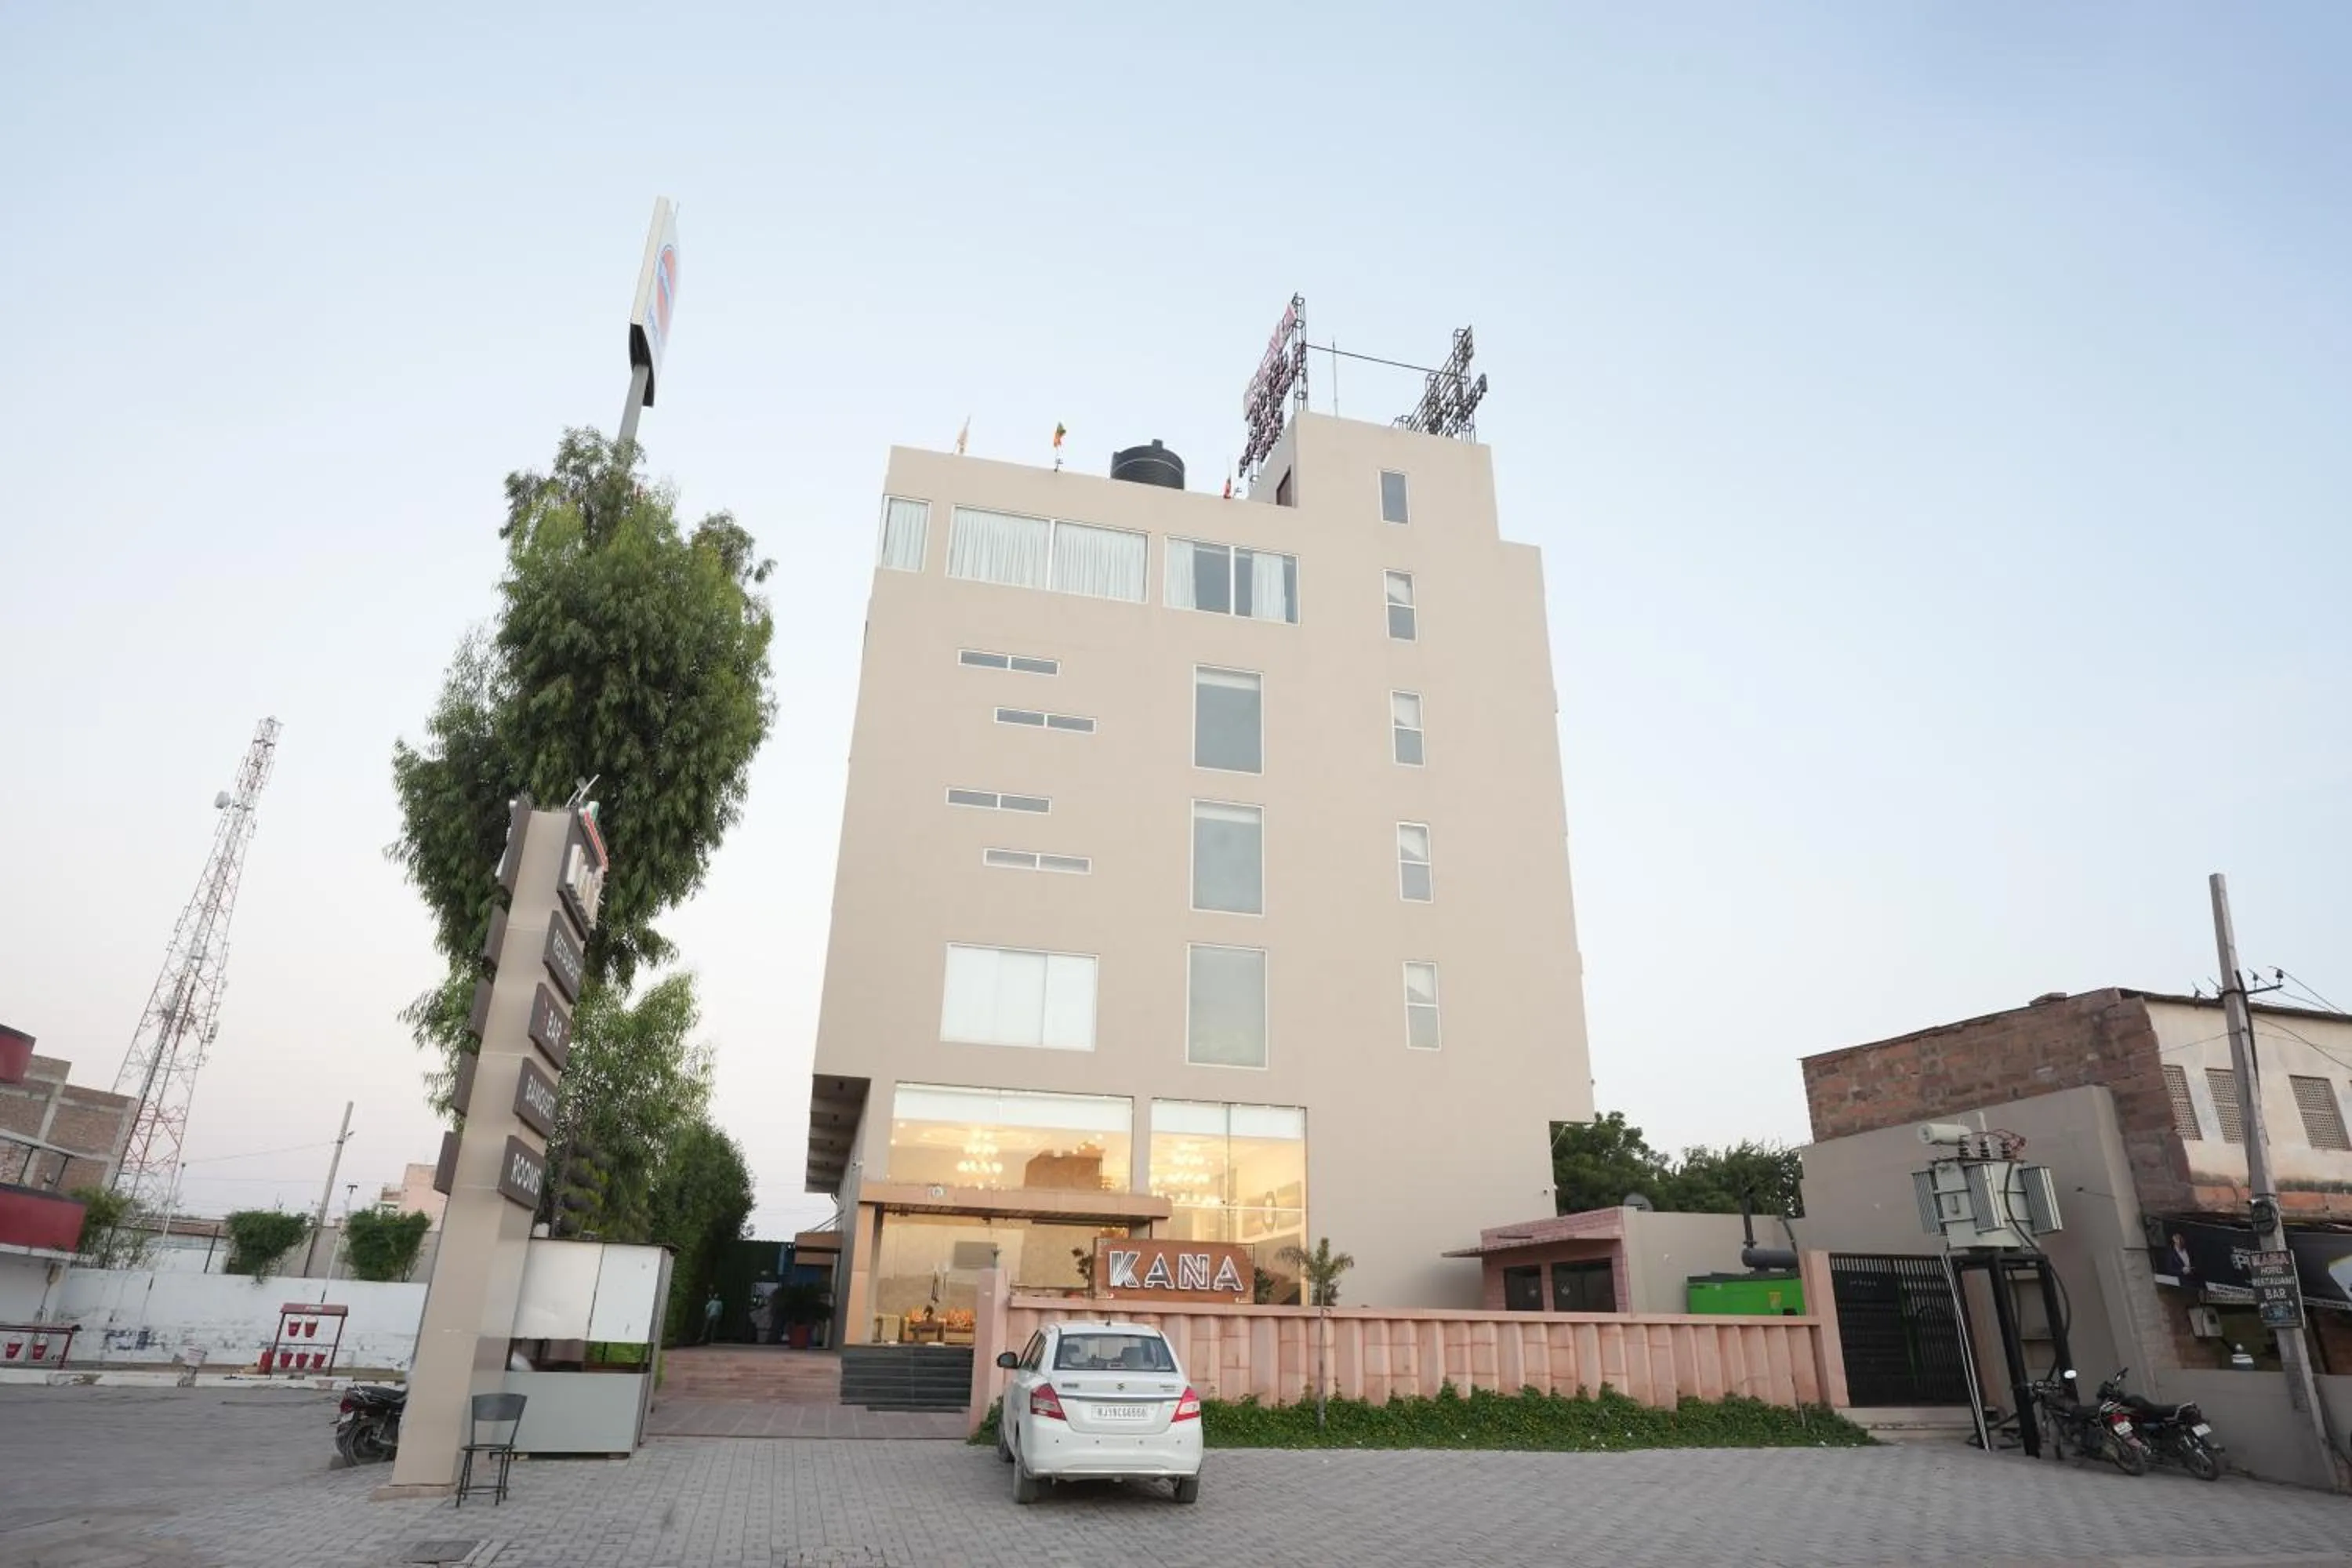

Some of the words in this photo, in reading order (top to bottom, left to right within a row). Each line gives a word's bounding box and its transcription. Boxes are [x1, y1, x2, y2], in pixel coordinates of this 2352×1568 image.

[546, 1008, 562, 1047] BAR
[526, 1074, 556, 1120] BANQUET
[510, 1152, 541, 1196] ROOMS
[1109, 1250, 1244, 1291] KANA
[2263, 1287, 2287, 1299] BAR
